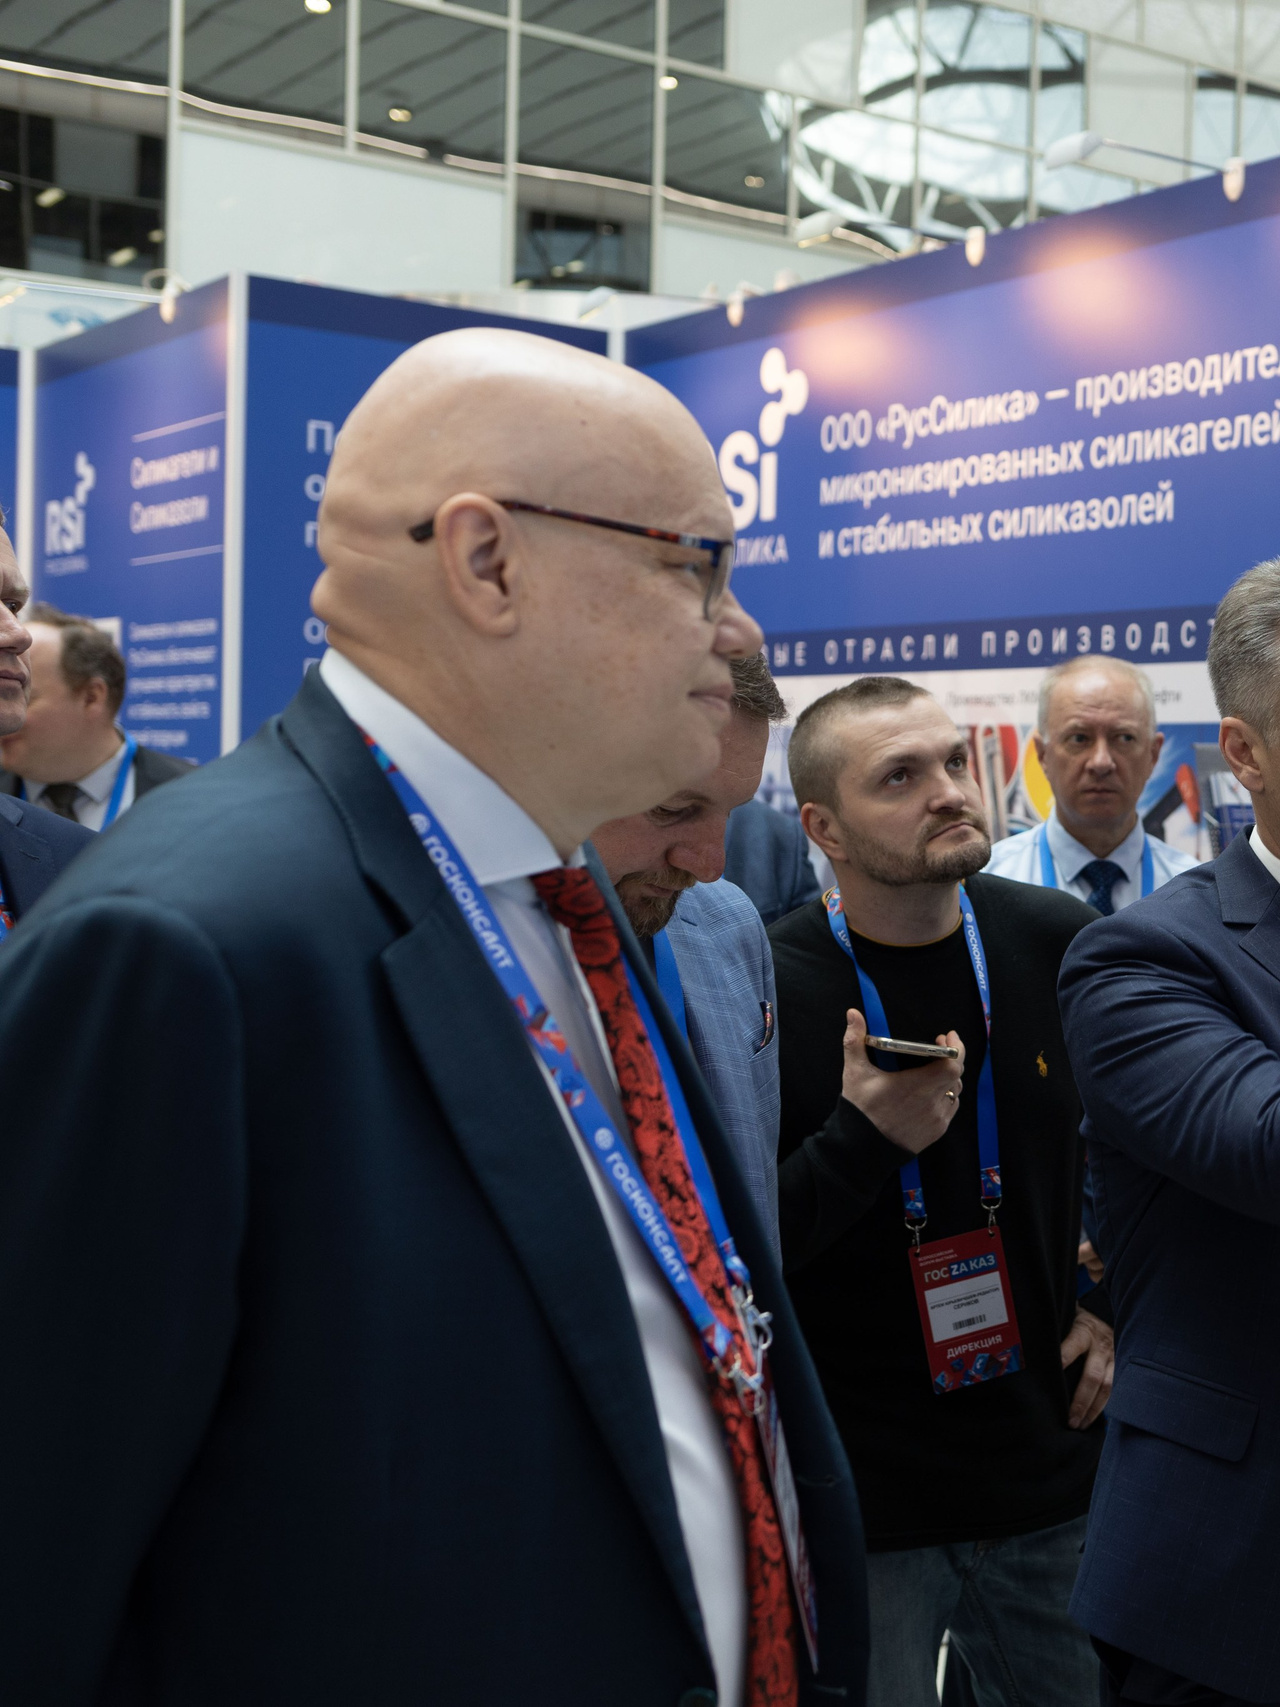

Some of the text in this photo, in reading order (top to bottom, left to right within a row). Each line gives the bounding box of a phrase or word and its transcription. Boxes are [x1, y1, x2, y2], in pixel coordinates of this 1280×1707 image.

[820, 408, 872, 453] ООО
[875, 389, 1039, 450] «РусСилика»
[719, 401, 785, 531] Si
[819, 439, 1084, 509] микронизированных
[734, 533, 789, 568] ЛИКА
[818, 479, 1174, 559] и стабильных силиказолей
[823, 633, 959, 666] ОТРАСЛИ
[981, 617, 1214, 658] ПРОИЗВОДС
[422, 836, 514, 969] ГОСКОНСАЛТ
[967, 925, 987, 991] ГОСКОНСАЛТ
[606, 1151, 688, 1284] ГОСКОНСАЛТ
[946, 1334, 1003, 1359] ДИРЕКЦИЯ
